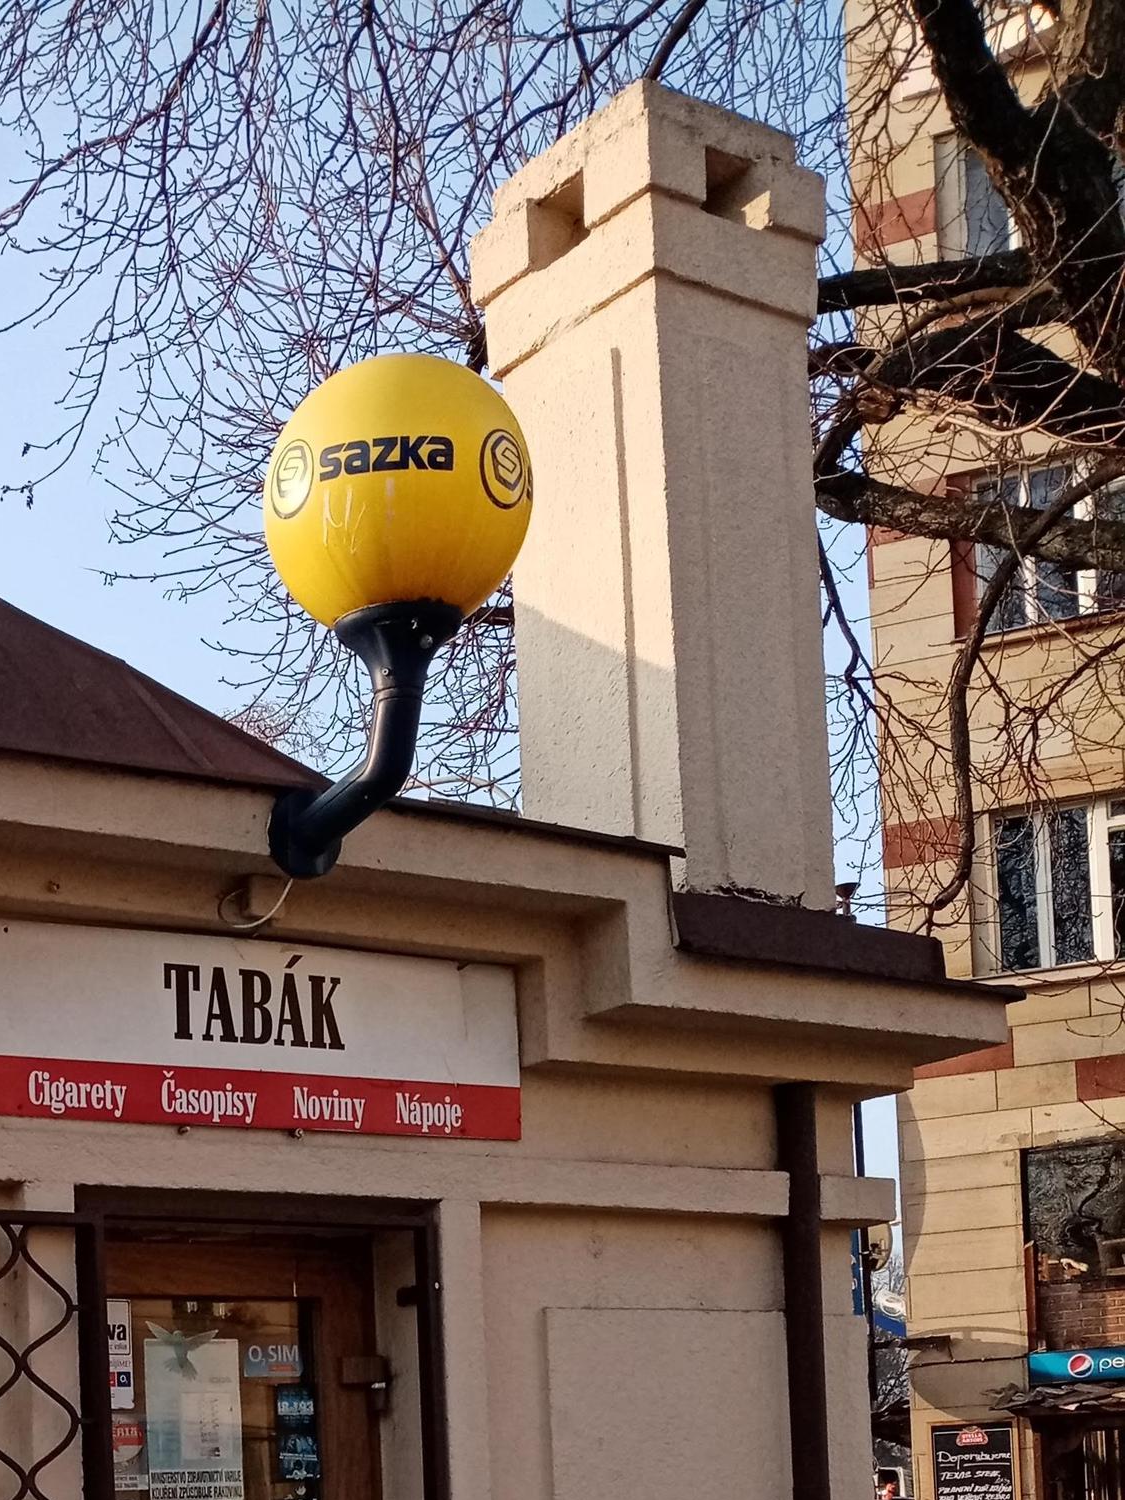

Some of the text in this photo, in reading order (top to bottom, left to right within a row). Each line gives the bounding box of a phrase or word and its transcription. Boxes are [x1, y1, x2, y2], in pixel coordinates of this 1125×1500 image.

[163, 954, 346, 1050] TABÁK
[28, 1070, 463, 1133] Cigarety Časopisy Noviny Nápoje
[267, 1345, 299, 1362] SIM
